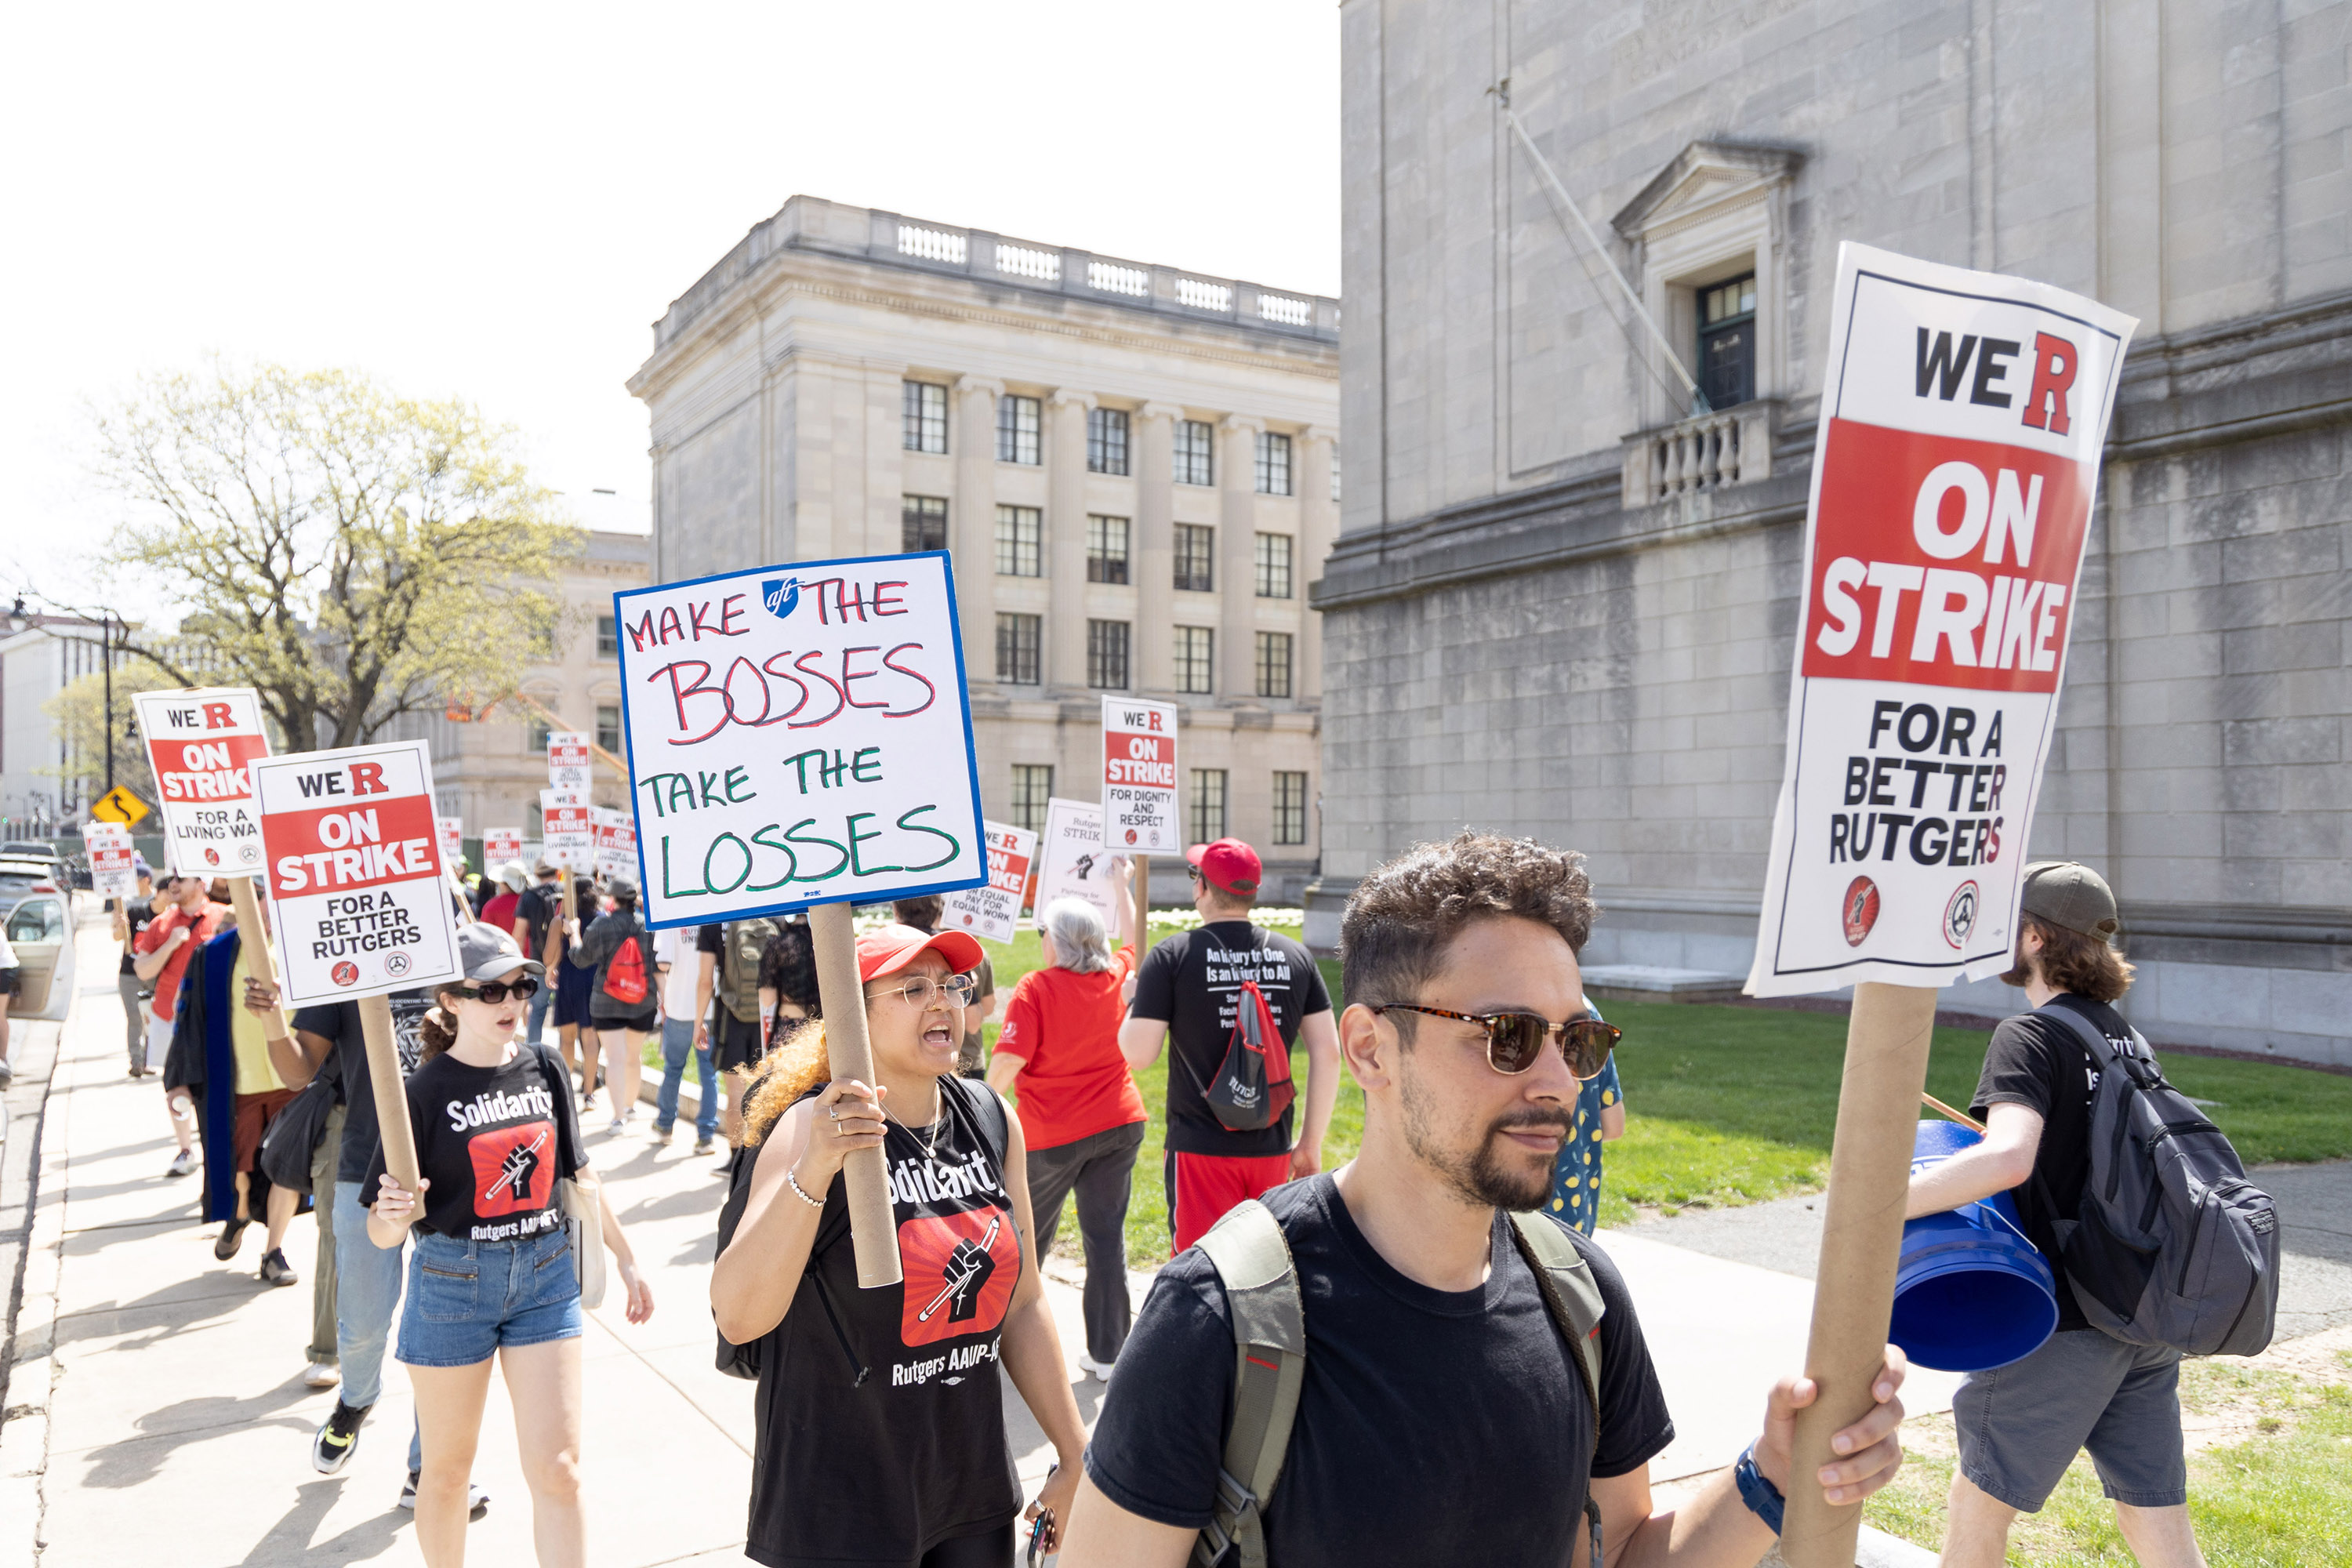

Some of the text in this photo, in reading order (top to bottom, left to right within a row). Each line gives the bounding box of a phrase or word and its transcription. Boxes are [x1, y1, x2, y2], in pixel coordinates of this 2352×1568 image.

[1915, 326, 2078, 437] WE R
[1913, 460, 2044, 568] ON
[766, 577, 805, 615] aft
[625, 578, 909, 652] MAKE THE
[1816, 556, 2067, 673] STRIKE
[648, 643, 935, 746] BOSSES
[167, 702, 238, 729] WE R
[1123, 710, 1163, 731] WE R
[1868, 699, 2003, 758] FOR A
[182, 742, 232, 771] ON
[561, 747, 578, 756] ON
[1129, 738, 1158, 760] ON
[551, 756, 586, 765] STRIKE
[162, 767, 252, 798] STRIK
[296, 762, 389, 798] WE R
[639, 746, 884, 817] TAKE THE
[1108, 758, 1174, 786] STRIKE
[1843, 756, 2007, 812] BETTER
[1110, 789, 1172, 804] FOR DIGNITY
[196, 809, 249, 824] FOR A
[559, 809, 575, 821] ON
[1133, 802, 1155, 815] AND
[176, 822, 258, 840] LIVING WA
[318, 808, 381, 849] ON
[546, 818, 586, 832] STRIKE
[1073, 818, 1101, 829] Rutger
[1120, 814, 1164, 827] RESPECT
[495, 840, 509, 849] ON
[613, 829, 630, 840] ON
[1002, 833, 1018, 851] R
[1063, 827, 1100, 841] STRIK
[1829, 812, 2005, 867] RUTGERS
[102, 851, 118, 860] ON
[486, 848, 519, 858] STRIKE
[662, 804, 960, 899] LOSSES
[94, 858, 132, 870] STRIKE
[277, 837, 434, 891] STRIKE
[989, 869, 1023, 893] IKE
[327, 891, 396, 916] FOR A
[966, 895, 1003, 910] PAY FOR
[967, 888, 1011, 904] OR EQUAL
[953, 900, 1011, 922] EQUAL WORK
[318, 908, 410, 938] BETTER
[312, 926, 422, 960] RUTGERS
[1263, 947, 1286, 963] One
[1207, 966, 1218, 982] Is
[1262, 965, 1276, 980] to
[1276, 964, 1290, 981] All
[1219, 1007, 1237, 1016] Facult
[446, 1085, 553, 1132] Solidarity
[471, 1221, 518, 1241] Rutgers
[892, 1334, 1001, 1386] Rutgers AAUP-AF
